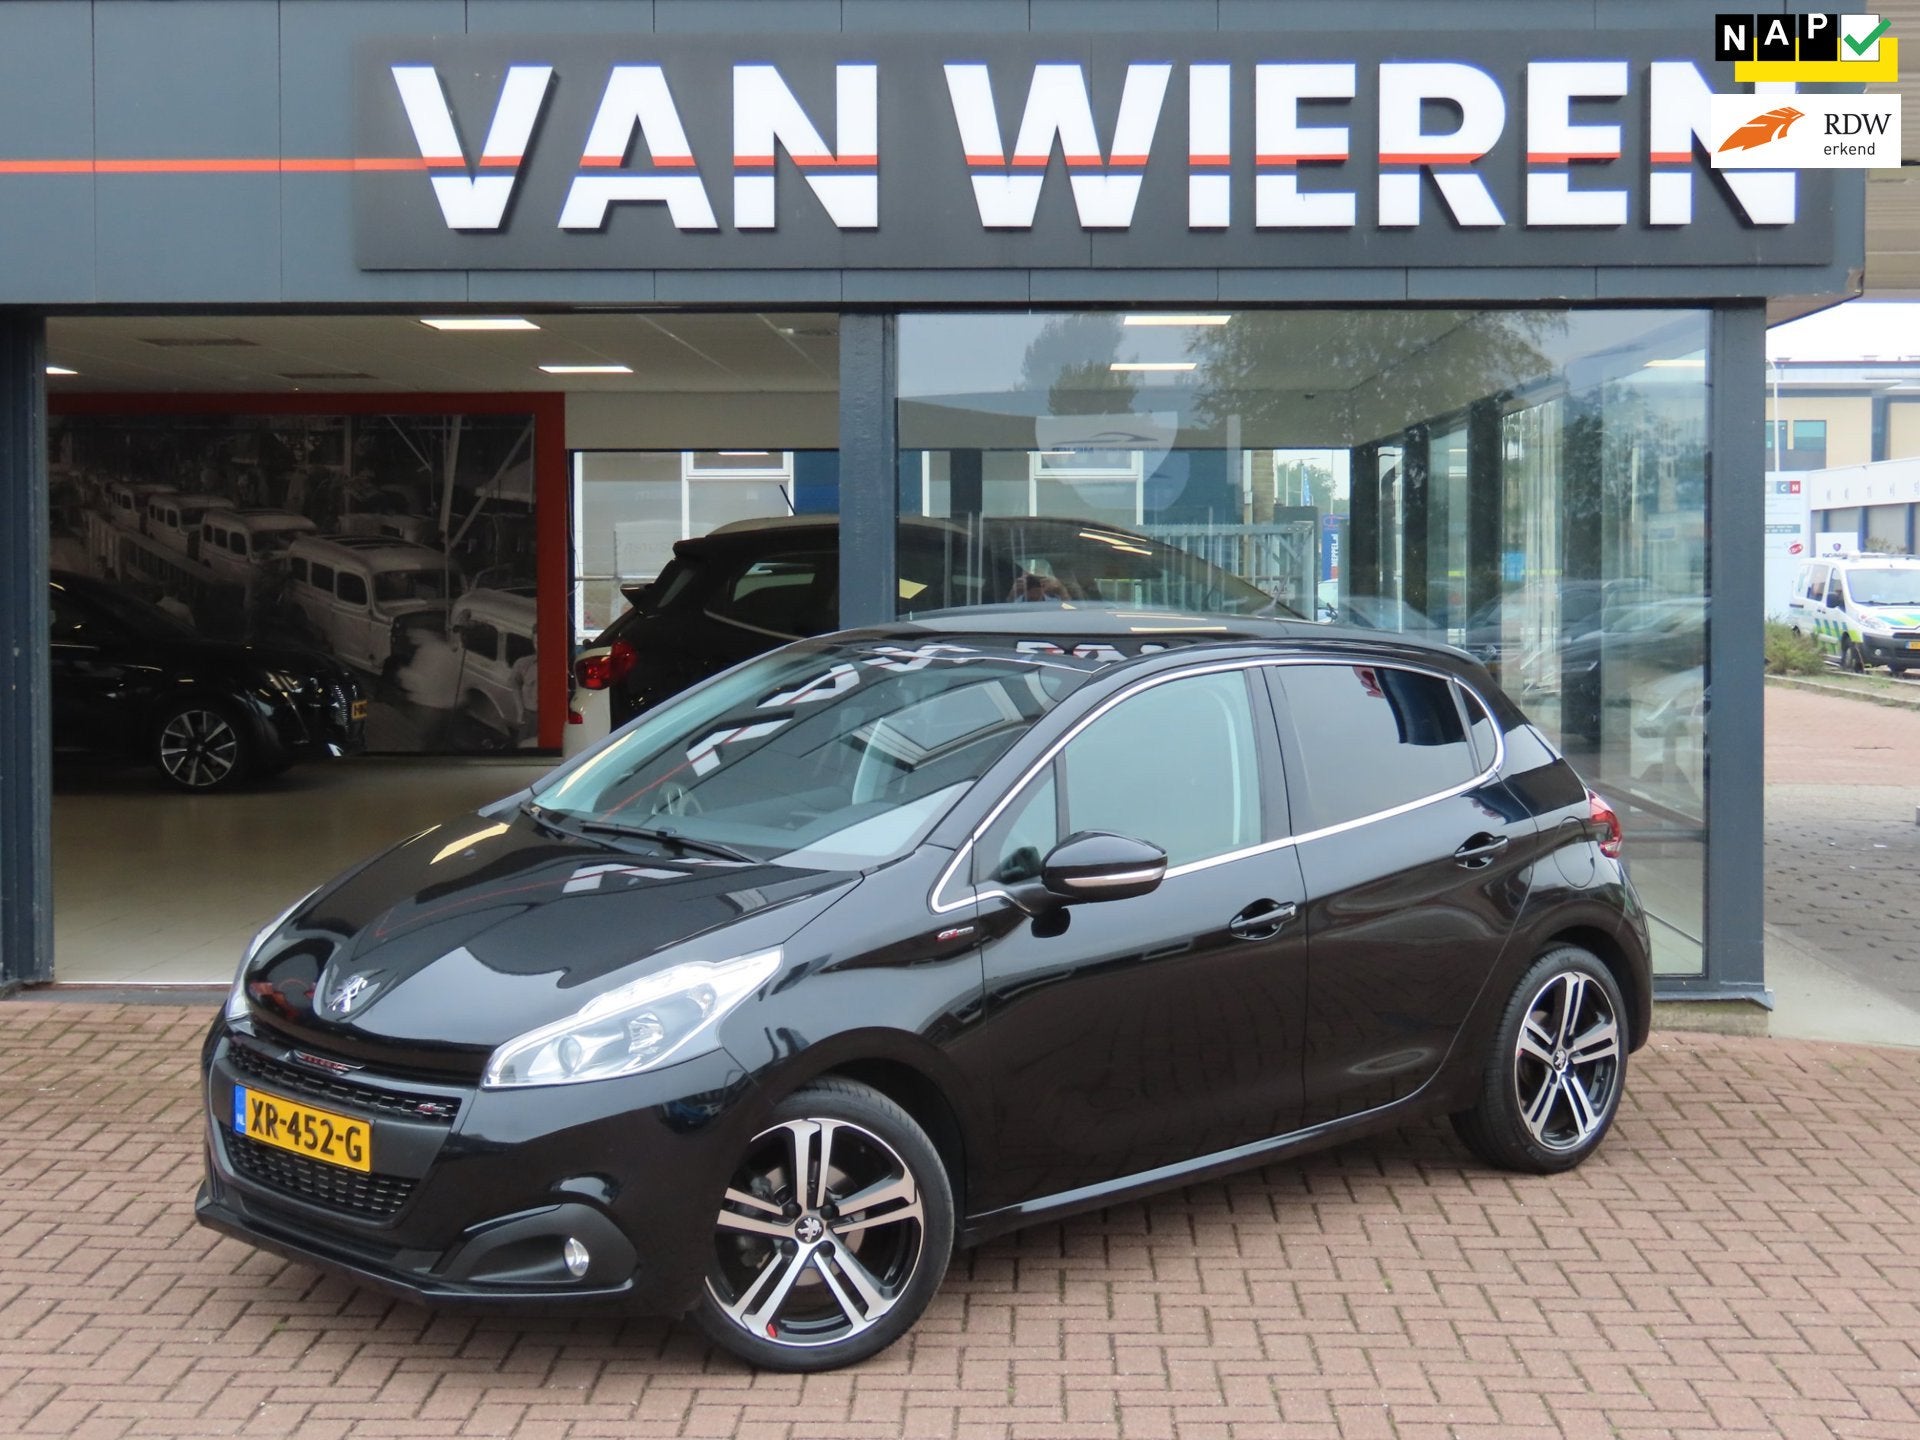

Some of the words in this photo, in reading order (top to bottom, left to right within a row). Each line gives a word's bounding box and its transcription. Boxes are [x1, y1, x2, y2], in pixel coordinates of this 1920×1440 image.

[391, 63, 879, 230] VAN
[943, 62, 1796, 229] WIEREN
[250, 1097, 363, 1163] XR-452-G
